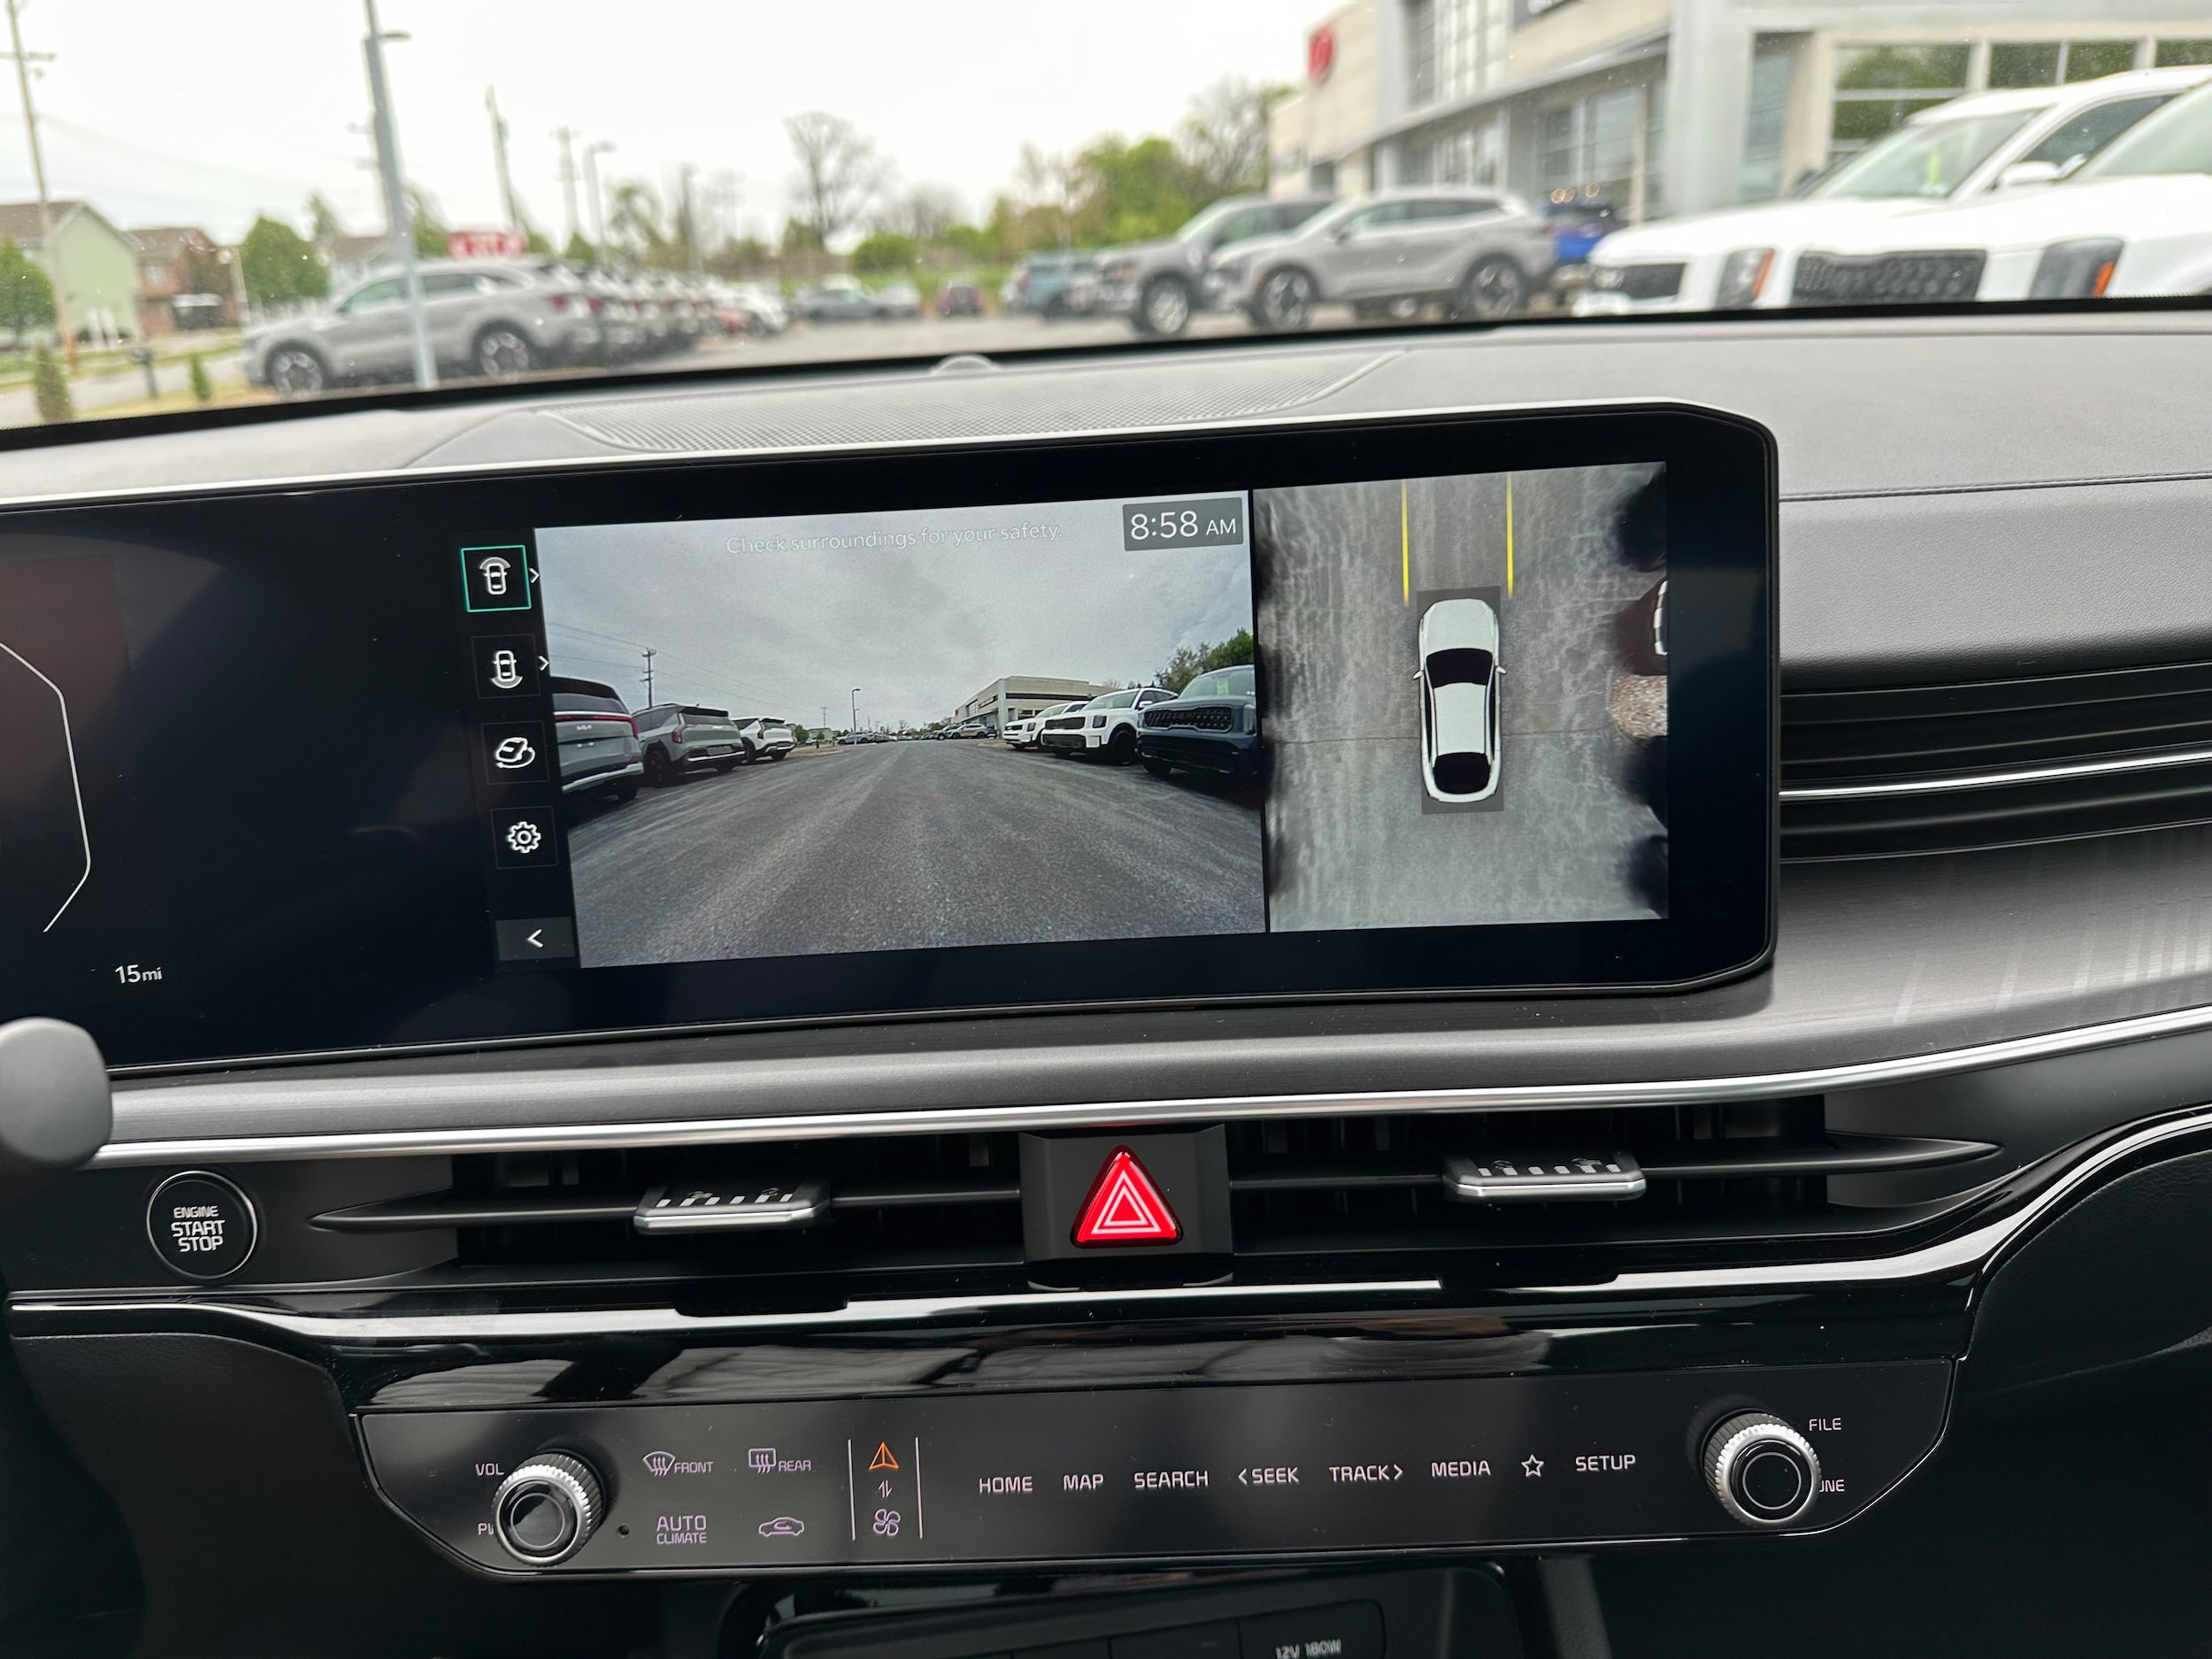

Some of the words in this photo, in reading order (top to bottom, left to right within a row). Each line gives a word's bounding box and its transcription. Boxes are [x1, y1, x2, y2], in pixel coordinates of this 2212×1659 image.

[1131, 510, 1199, 541] 8:58
[1205, 518, 1236, 536] AM
[726, 534, 787, 554] Check
[790, 530, 917, 549] surroundings
[920, 527, 949, 544] for
[953, 527, 996, 546] your
[1000, 522, 1063, 541] safety.
[173, 1205, 219, 1219] ENGINE
[170, 1219, 226, 1238] START
[177, 1235, 224, 1252] STOP
[1809, 1417, 1842, 1432] FILE
[475, 1463, 505, 1477] VOL
[673, 1461, 714, 1474] FRONT
[778, 1459, 811, 1472] REAR
[1431, 1459, 1491, 1478] MEDIA
[1574, 1454, 1636, 1472] SETUP
[1063, 1473, 1104, 1491] MAP
[1133, 1470, 1209, 1488] SEARCH
[1251, 1466, 1300, 1484] SEEK
[1329, 1464, 1389, 1482] TRACK
[979, 1476, 1033, 1494] HOME
[657, 1515, 707, 1532] AUTO
[656, 1532, 708, 1545] CLIMATE
[1275, 1644, 1300, 1659] 12V
